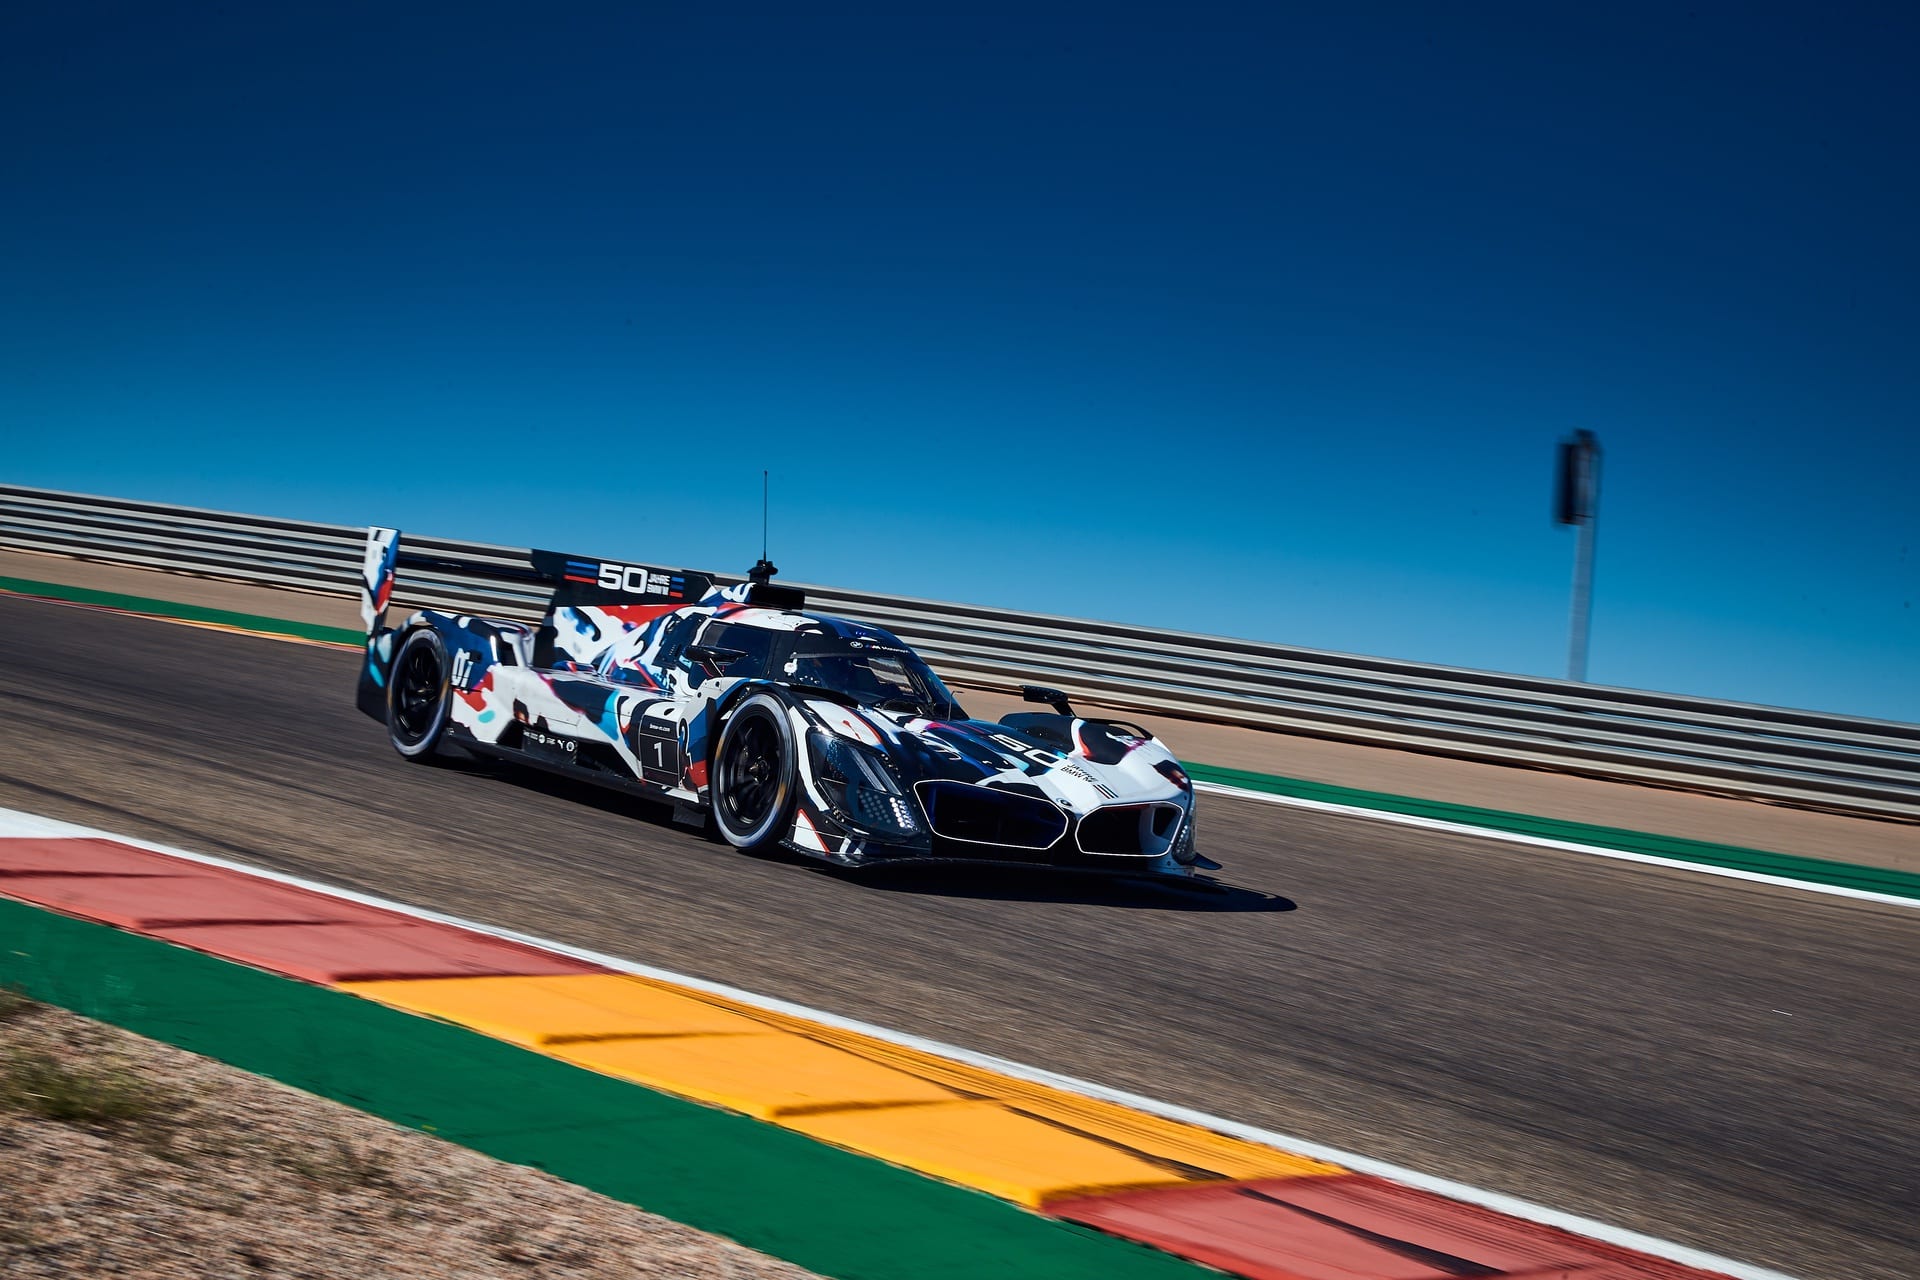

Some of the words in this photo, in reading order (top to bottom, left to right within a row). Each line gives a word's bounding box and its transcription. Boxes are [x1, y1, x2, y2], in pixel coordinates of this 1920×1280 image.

[598, 562, 648, 594] 50
[653, 741, 663, 768] 1
[989, 734, 1061, 768] 50
